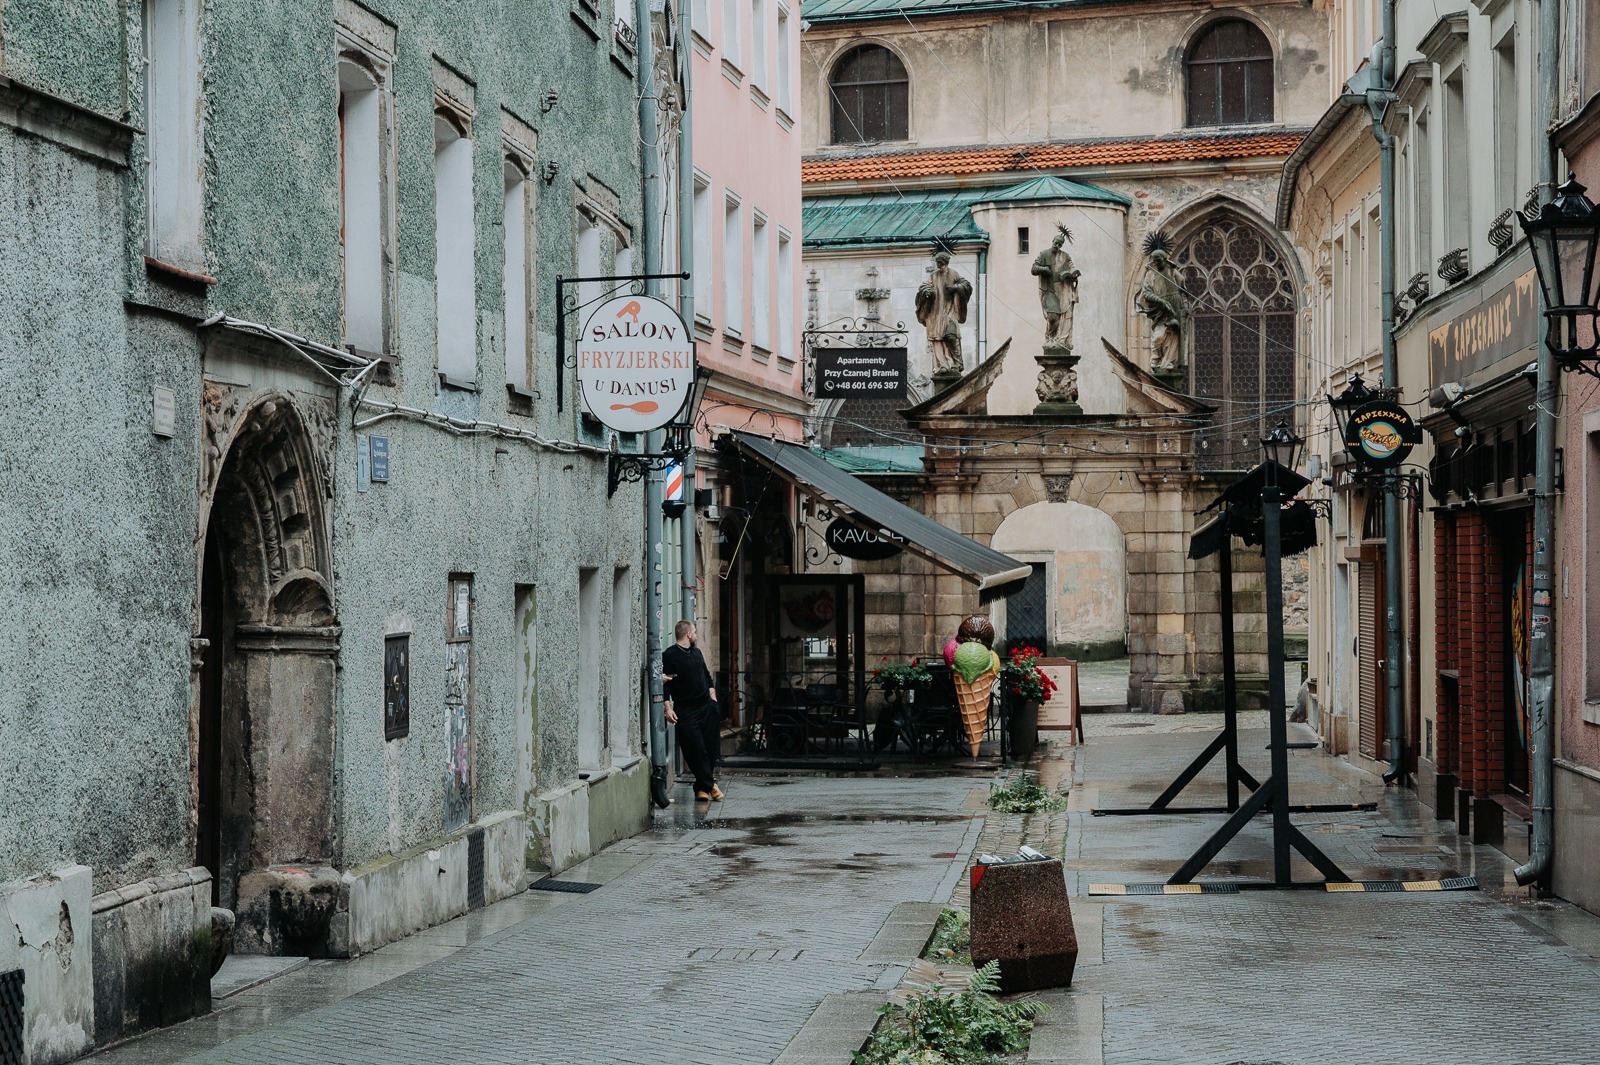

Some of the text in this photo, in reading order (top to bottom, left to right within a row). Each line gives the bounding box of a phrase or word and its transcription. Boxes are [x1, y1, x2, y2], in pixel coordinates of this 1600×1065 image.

[592, 321, 677, 342] SALON
[1454, 294, 1512, 362] ZAPIEKANKI
[580, 351, 690, 369] FRYZJERSKI
[837, 356, 886, 365] Apartamenty
[824, 369, 899, 378] Przy Czarnej Bramie
[595, 378, 677, 396] U DANUSI
[1354, 410, 1407, 424] ZAPIEXXXA
